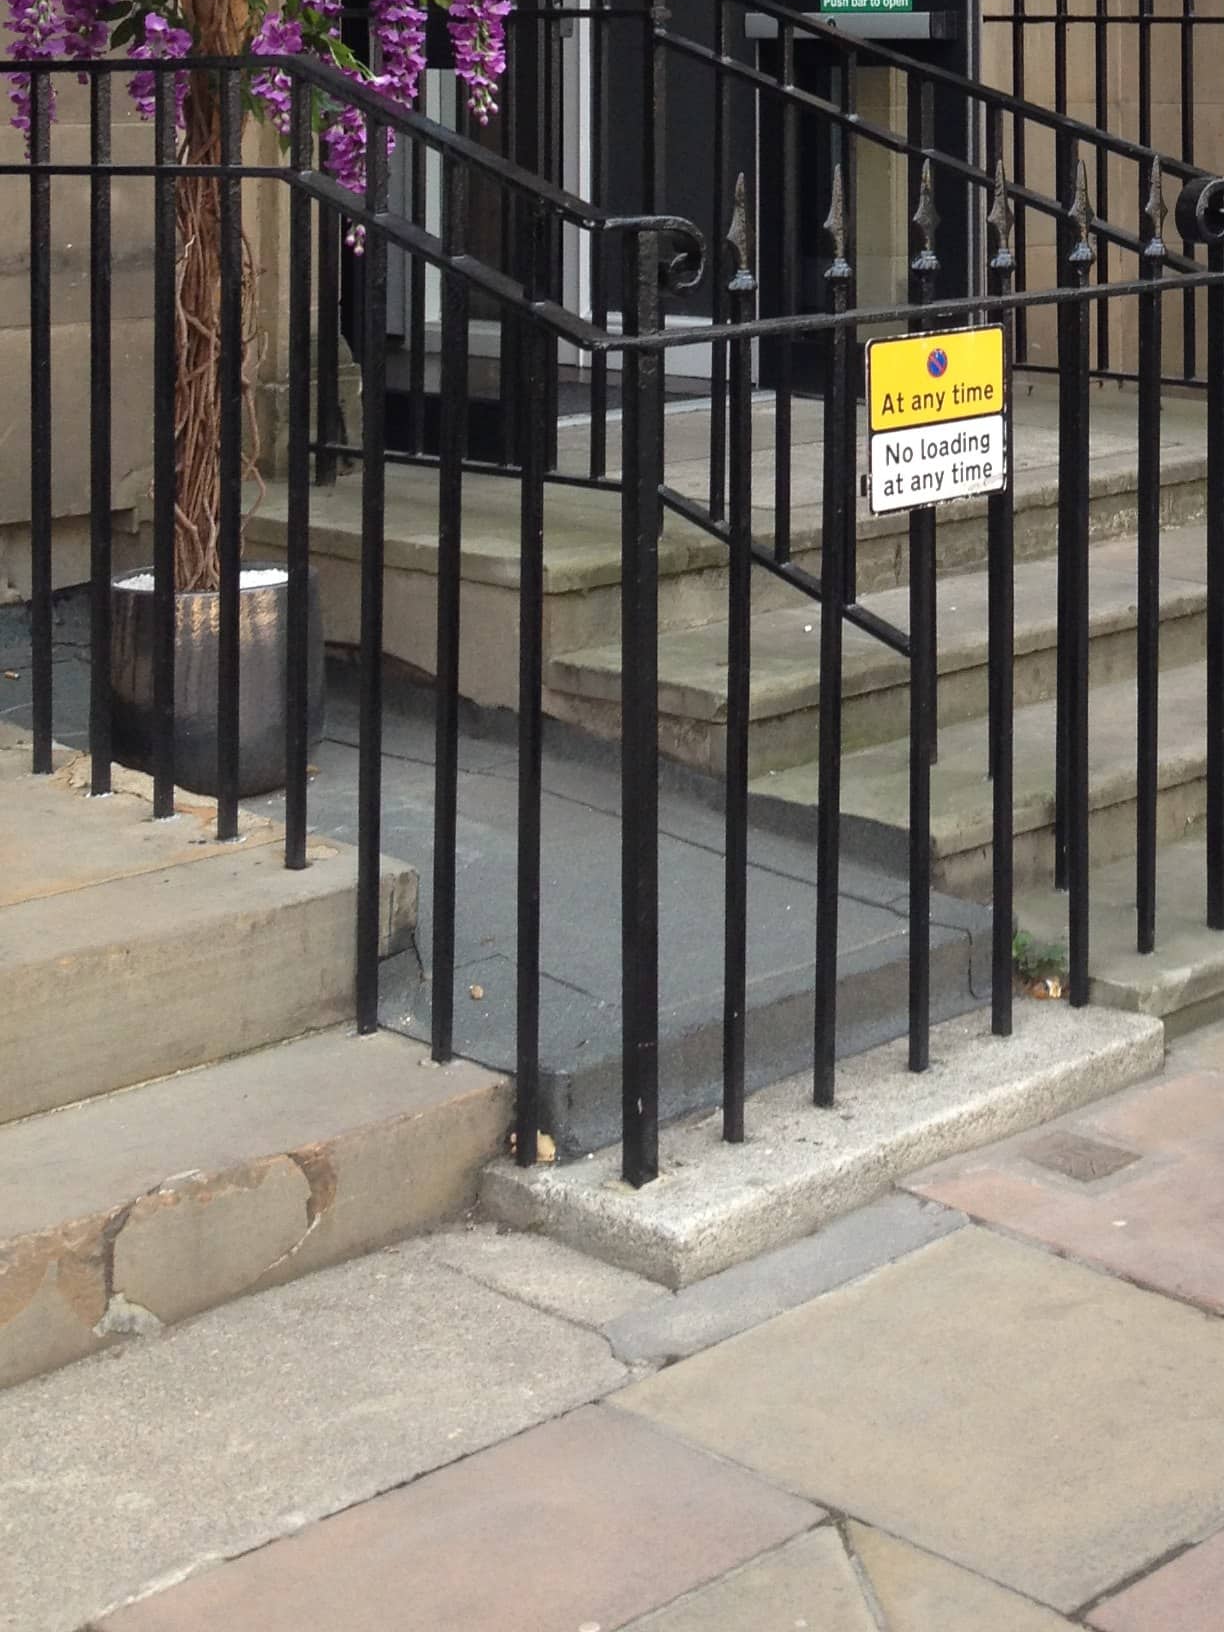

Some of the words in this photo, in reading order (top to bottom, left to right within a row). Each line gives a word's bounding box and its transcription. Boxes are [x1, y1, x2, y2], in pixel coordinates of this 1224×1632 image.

[881, 391, 904, 416] At
[911, 390, 946, 412] any
[952, 382, 994, 405] time
[885, 442, 914, 466] No
[921, 431, 990, 460] loading
[883, 472, 904, 497] at
[910, 469, 945, 492] any
[952, 461, 993, 485] time
